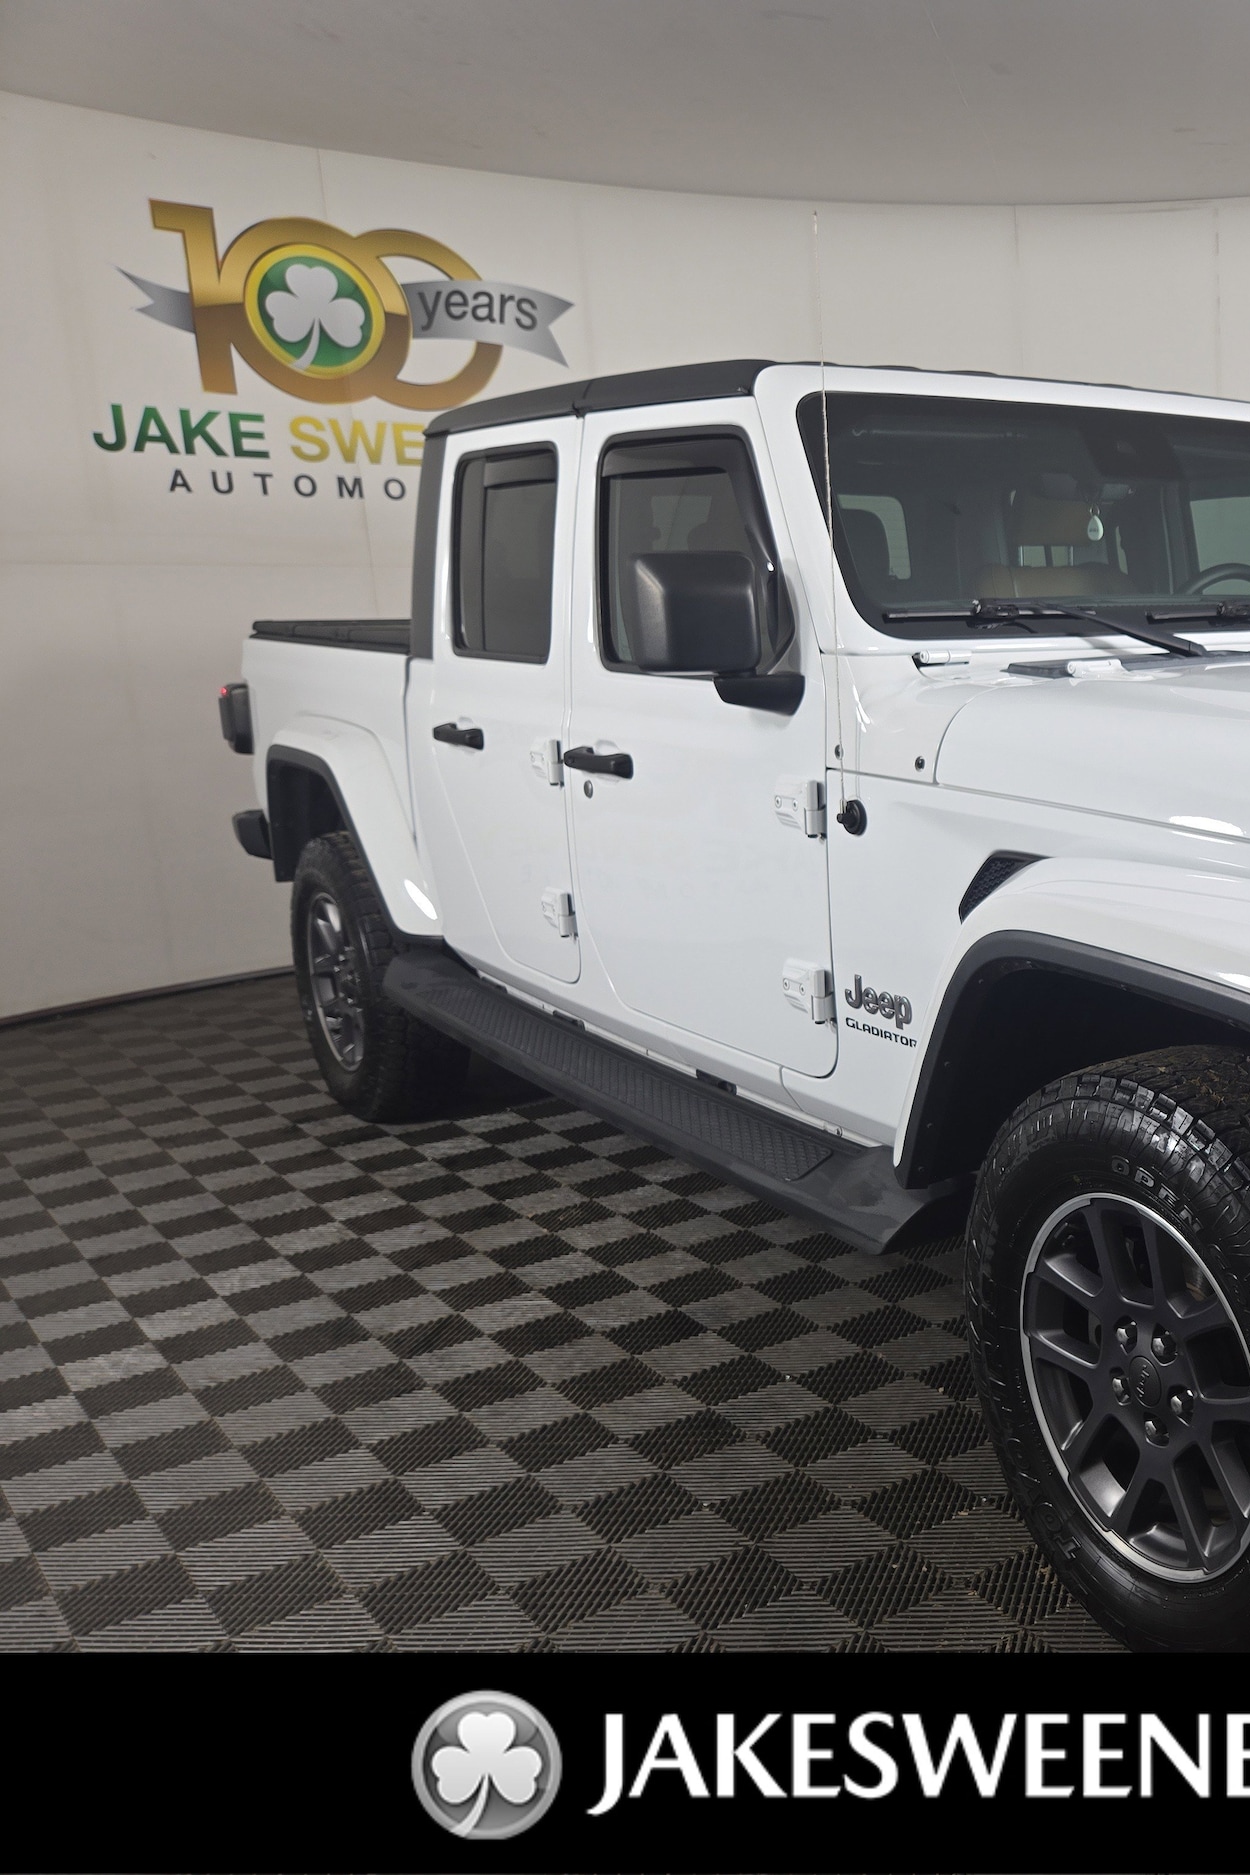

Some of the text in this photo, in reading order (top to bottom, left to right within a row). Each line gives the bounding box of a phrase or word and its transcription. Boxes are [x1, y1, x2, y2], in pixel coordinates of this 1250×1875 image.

[417, 286, 539, 333] years
[92, 403, 425, 467] JAKE SWE
[169, 468, 406, 500] AUTOMO
[844, 973, 912, 1030] Jeep
[845, 1017, 917, 1048] GLADIATOR
[1111, 1154, 1204, 1233] OPEN
